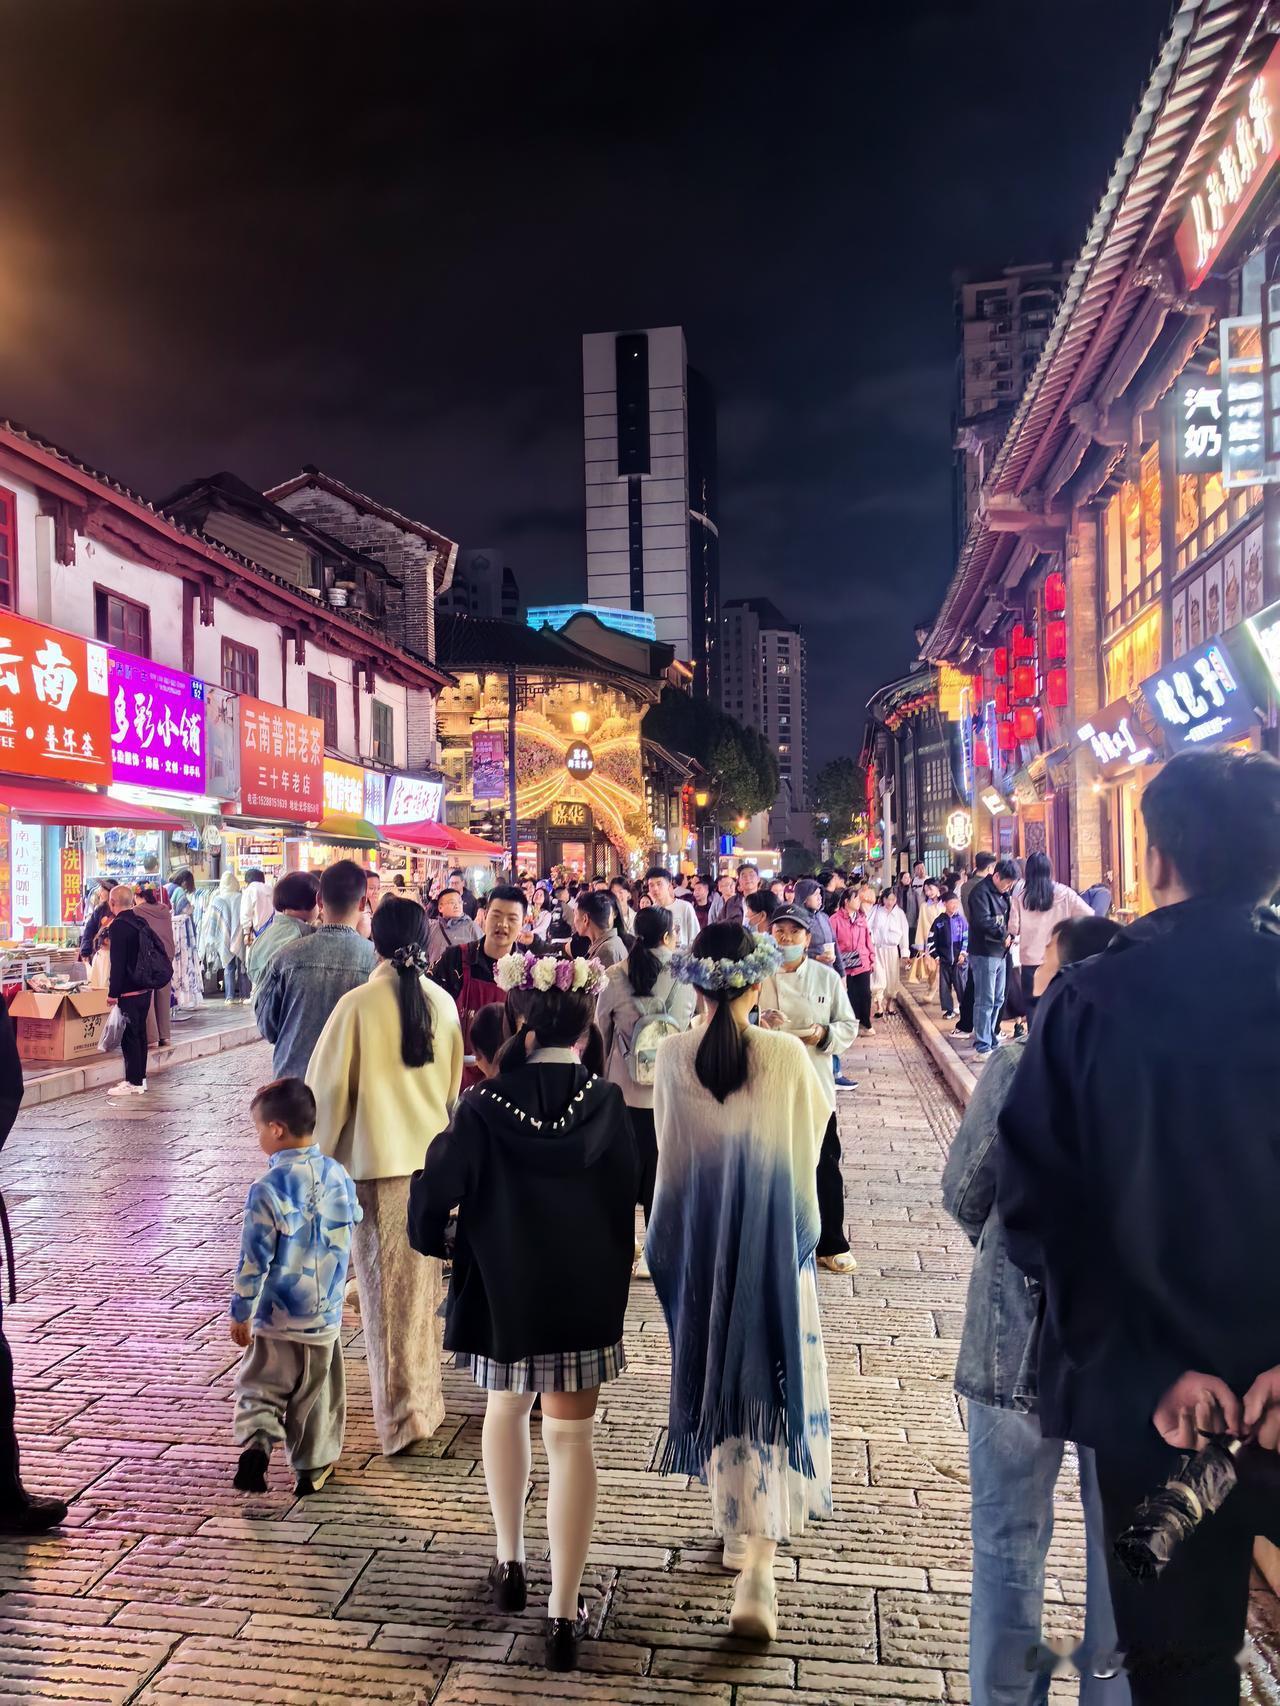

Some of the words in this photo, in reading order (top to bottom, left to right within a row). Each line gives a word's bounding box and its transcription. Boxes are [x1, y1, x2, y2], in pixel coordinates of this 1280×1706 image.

[244, 710, 320, 766] 云南普洱老茶
[258, 766, 311, 795] 三十年老店
[63, 849, 81, 919] 洗照片
